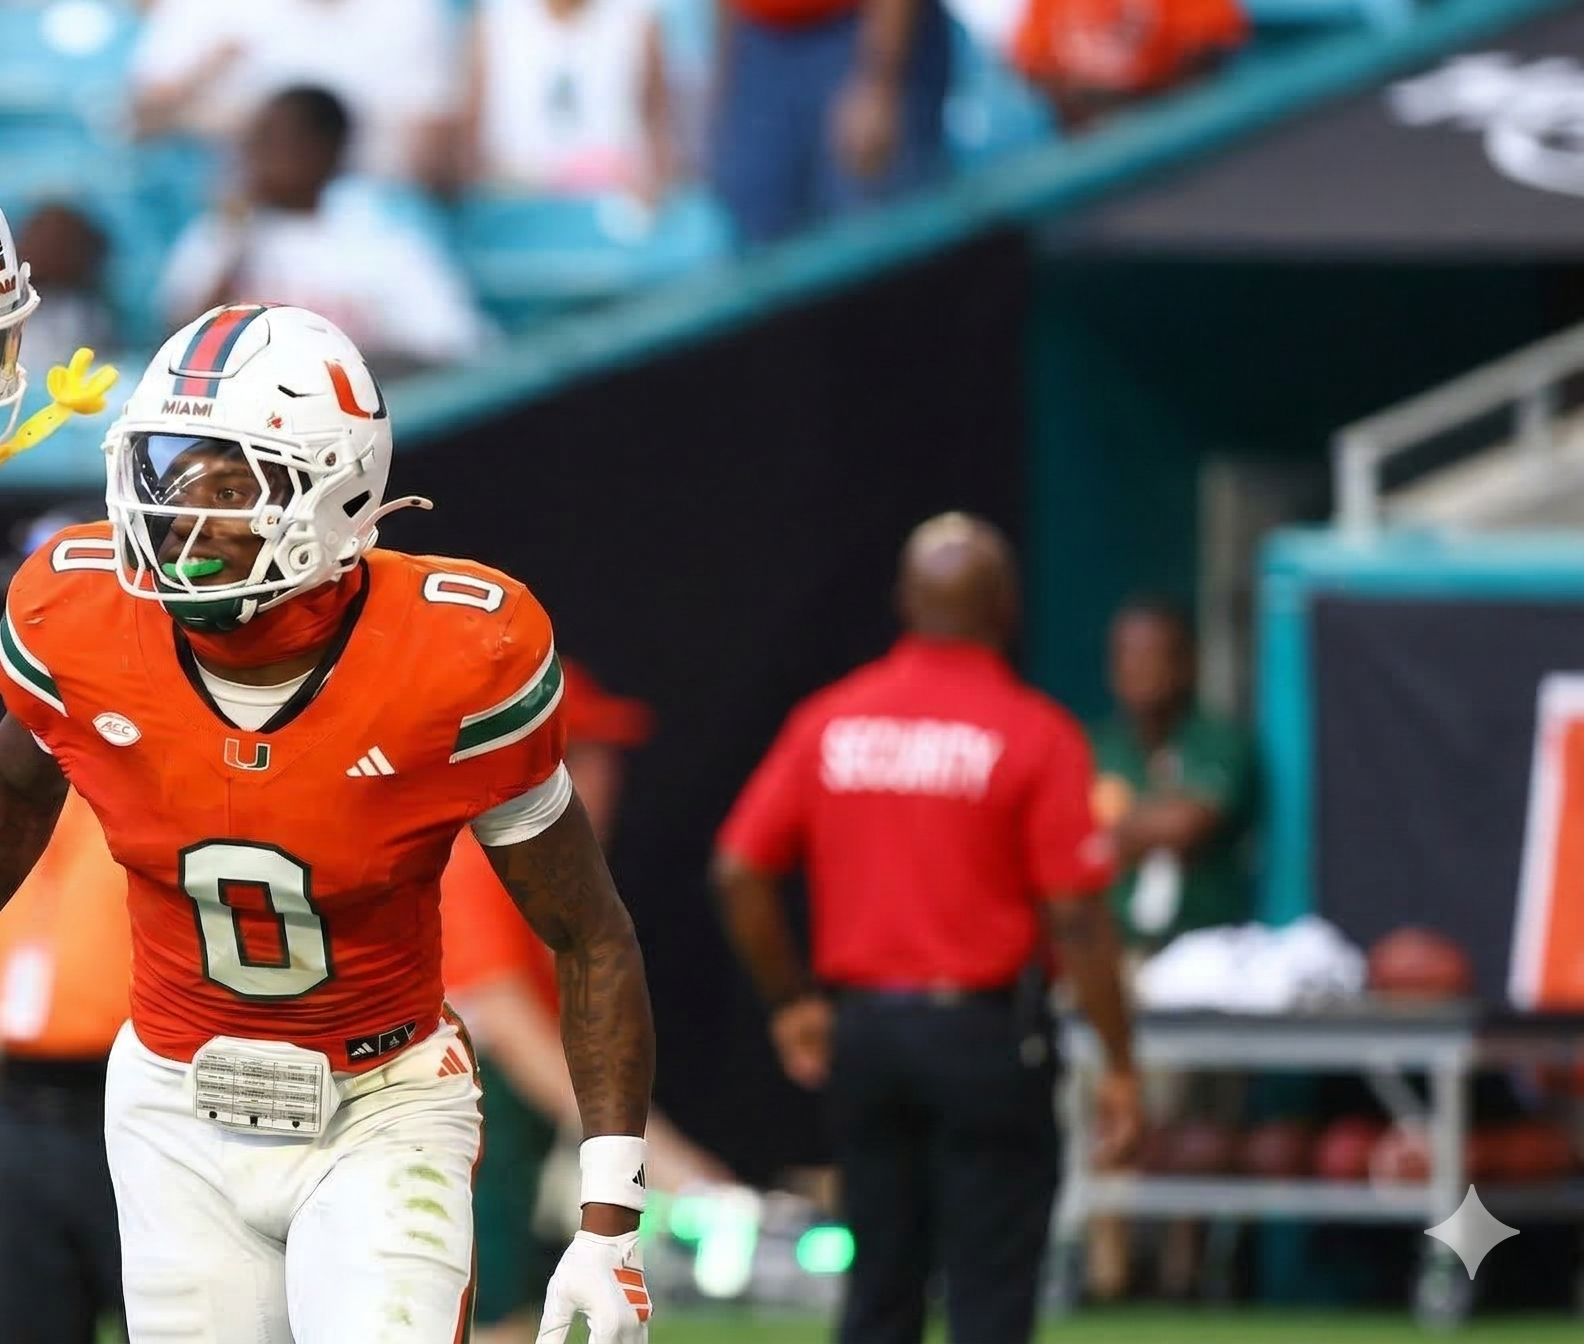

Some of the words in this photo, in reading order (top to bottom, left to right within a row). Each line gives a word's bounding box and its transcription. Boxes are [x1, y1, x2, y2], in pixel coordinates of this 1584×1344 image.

[161, 399, 213, 418] MIAMI
[422, 571, 505, 614] 0
[224, 738, 270, 771] U
[821, 716, 1005, 803] SECURITY
[179, 838, 338, 999] 0
